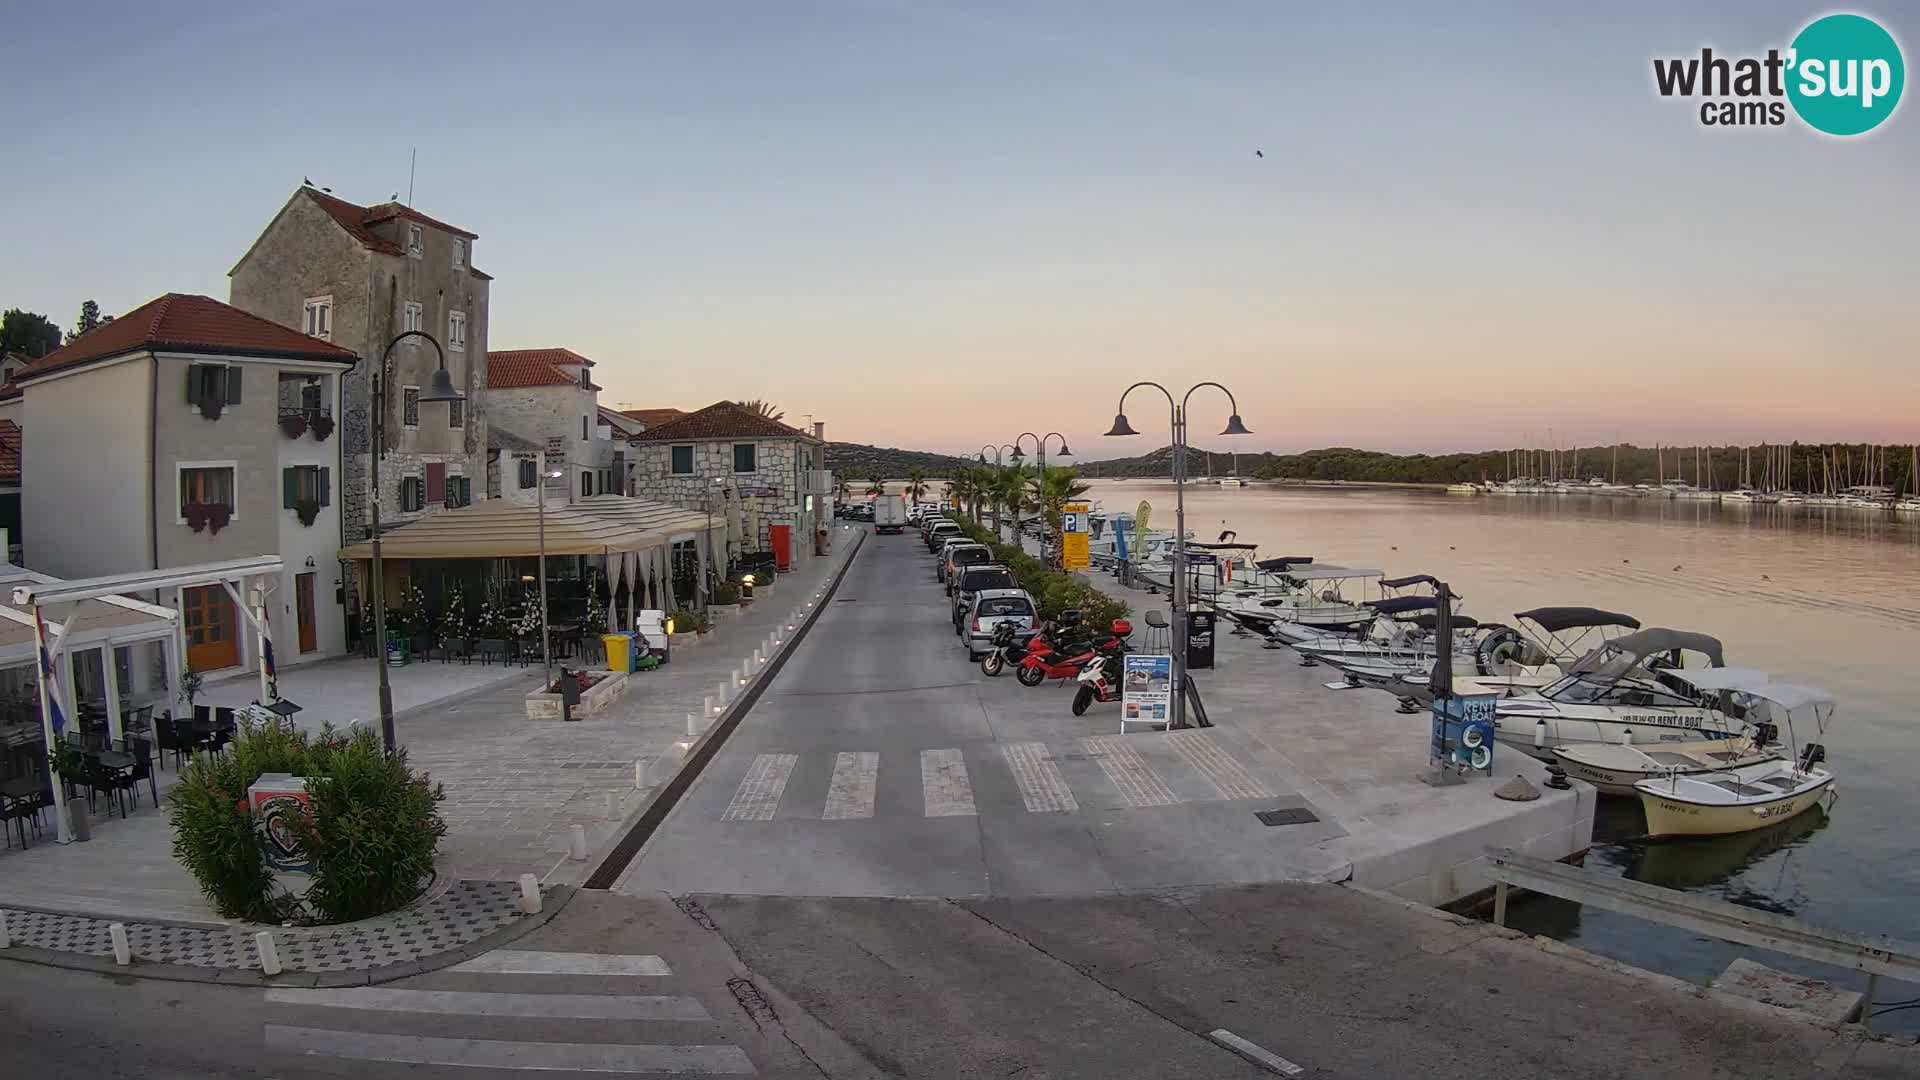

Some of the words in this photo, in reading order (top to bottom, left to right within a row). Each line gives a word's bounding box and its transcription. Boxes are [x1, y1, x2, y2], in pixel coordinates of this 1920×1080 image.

[1065, 514, 1075, 531] P
[1464, 703, 1495, 712] RENT
[1463, 713, 1469, 721] A
[1471, 712, 1494, 721] BOAT
[1657, 715, 1677, 725] RENT
[1684, 716, 1704, 728] BOAT
